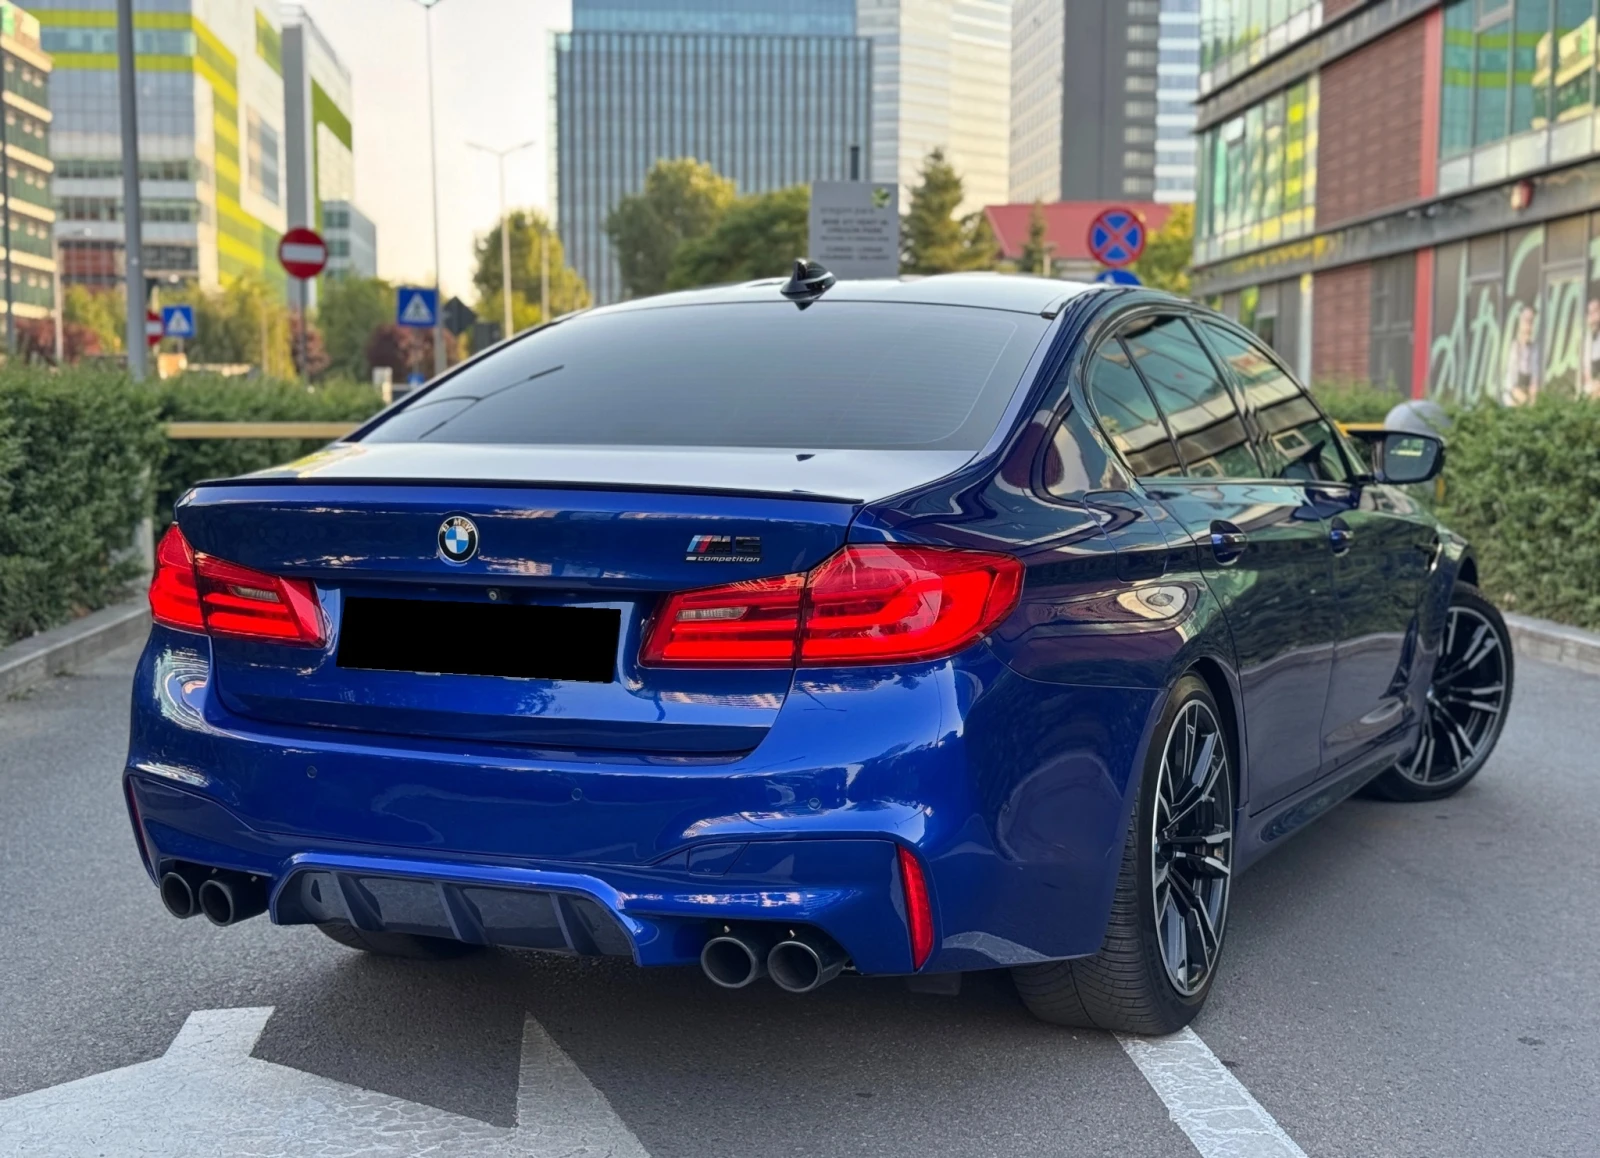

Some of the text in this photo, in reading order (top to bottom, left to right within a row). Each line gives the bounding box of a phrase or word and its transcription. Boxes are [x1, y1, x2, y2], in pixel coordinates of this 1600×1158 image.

[440, 518, 474, 533] BMW
[687, 535, 761, 553] M5
[698, 555, 760, 563] competition
